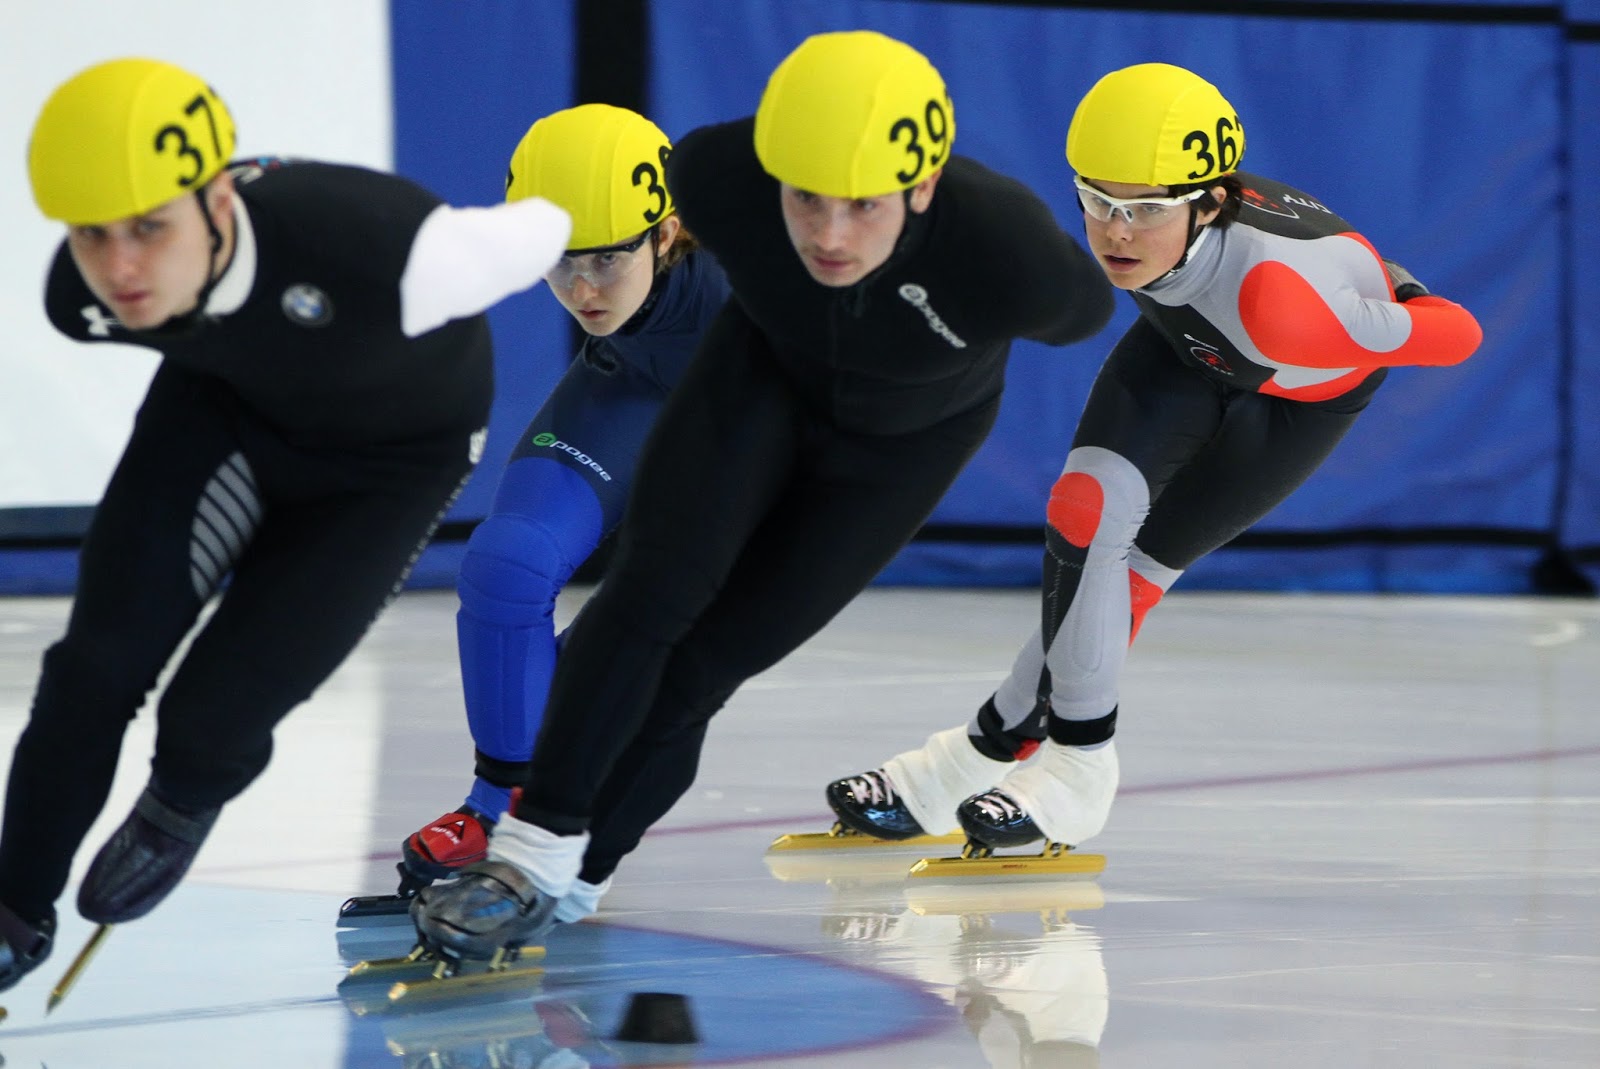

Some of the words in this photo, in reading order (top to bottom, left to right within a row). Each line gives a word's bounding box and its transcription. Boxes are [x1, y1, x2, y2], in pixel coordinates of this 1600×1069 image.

[154, 92, 226, 187] 37
[889, 97, 950, 185] 39
[532, 432, 612, 482] apogee
